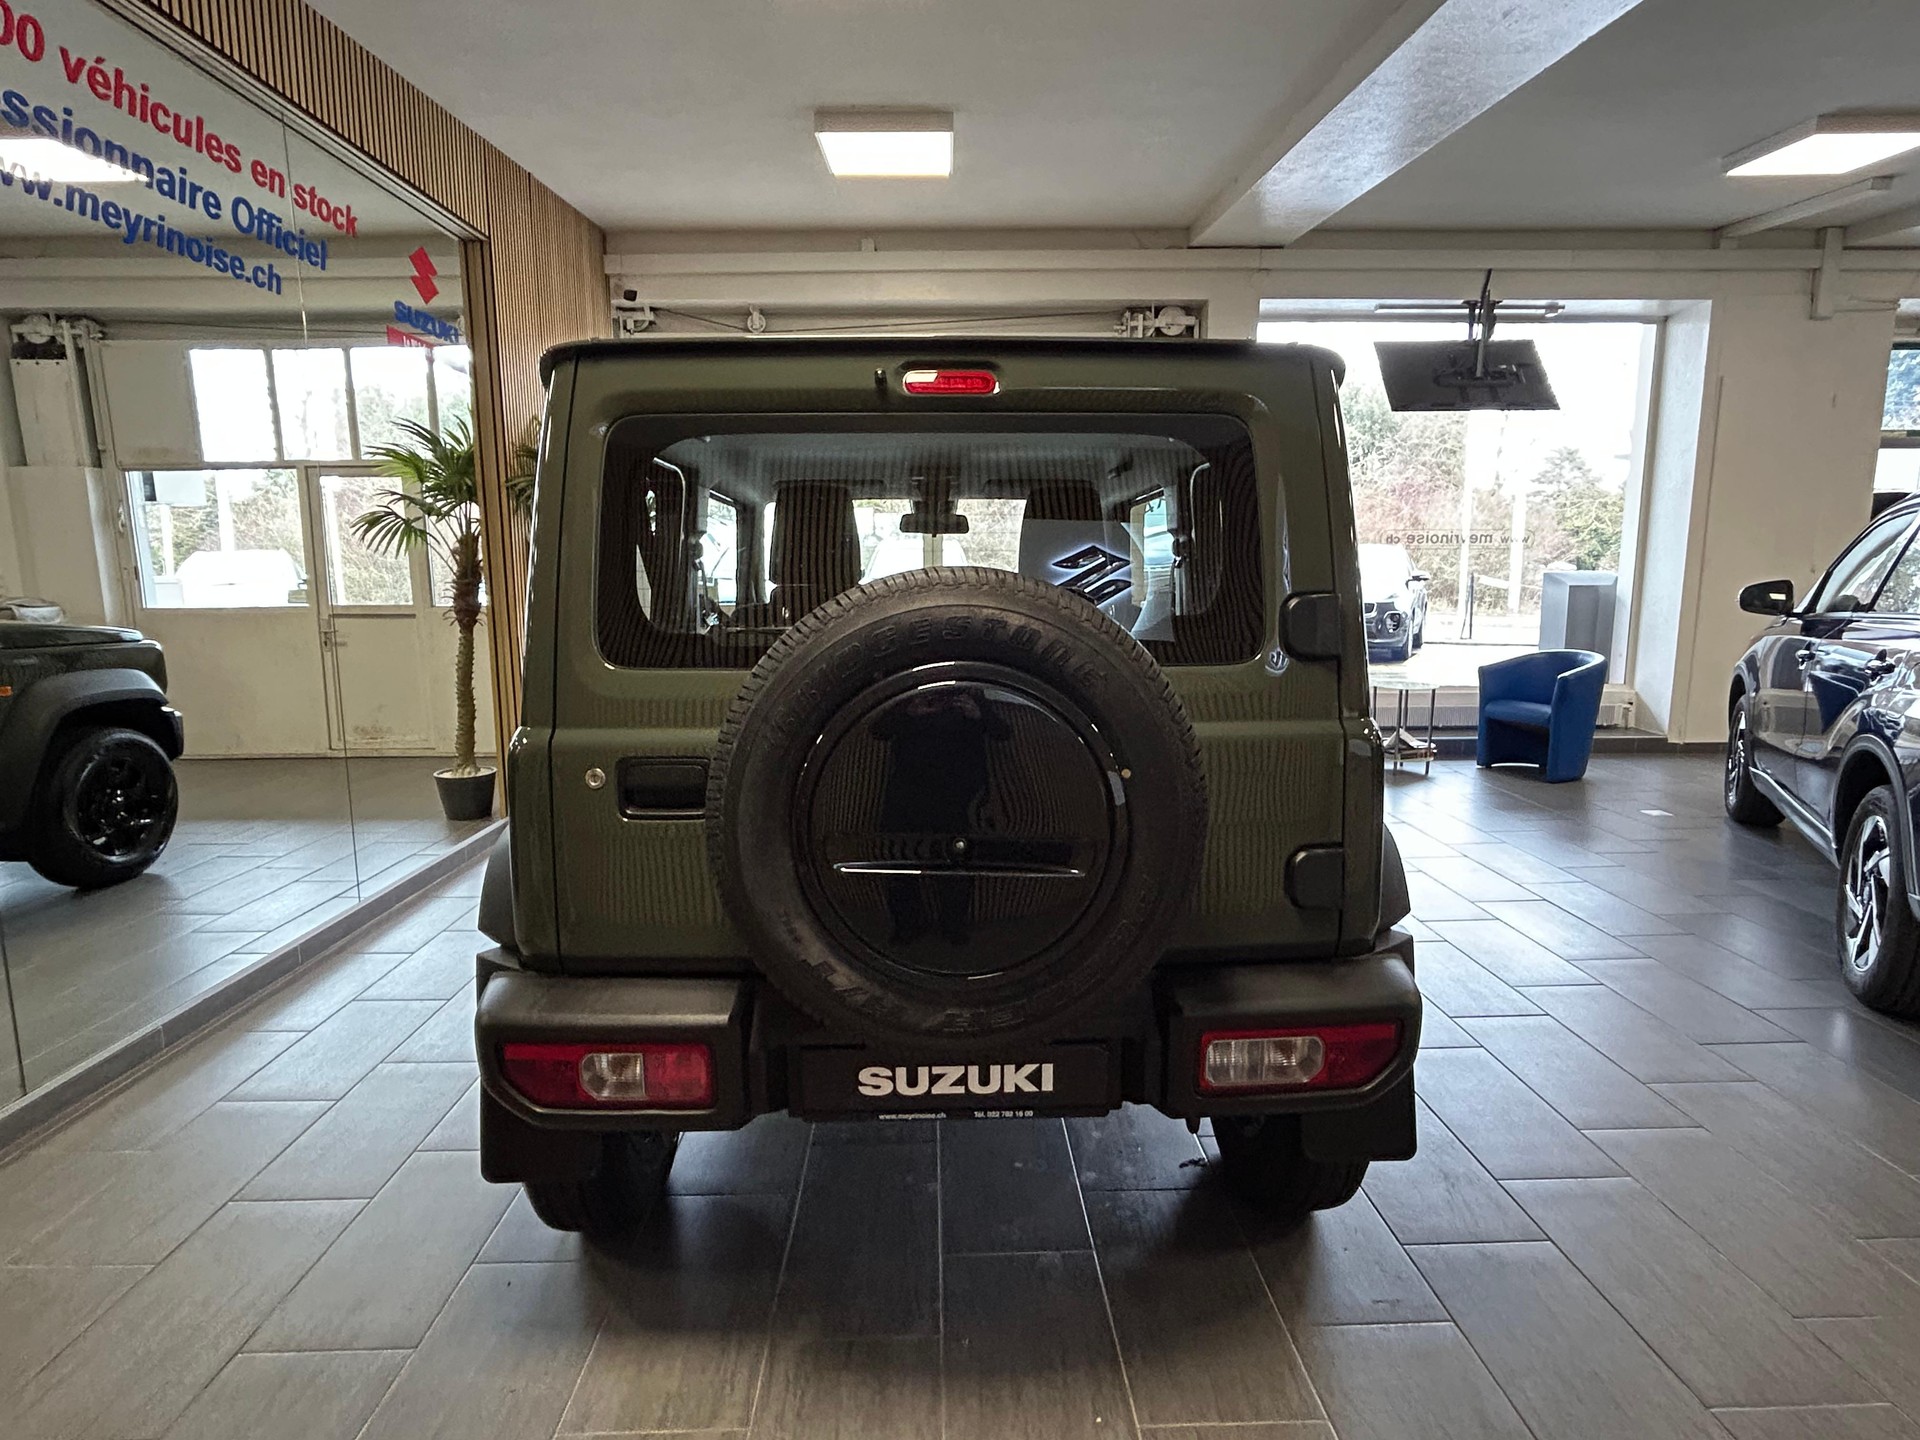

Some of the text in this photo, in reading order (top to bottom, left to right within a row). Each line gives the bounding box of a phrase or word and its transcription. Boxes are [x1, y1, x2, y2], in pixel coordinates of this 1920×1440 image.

[59, 46, 242, 174] véhicules
[251, 159, 285, 198] en
[293, 183, 358, 239] stock
[231, 196, 328, 270] Officiel
[394, 300, 460, 344] SUZUKI
[857, 1063, 1054, 1097] SUZUKI
